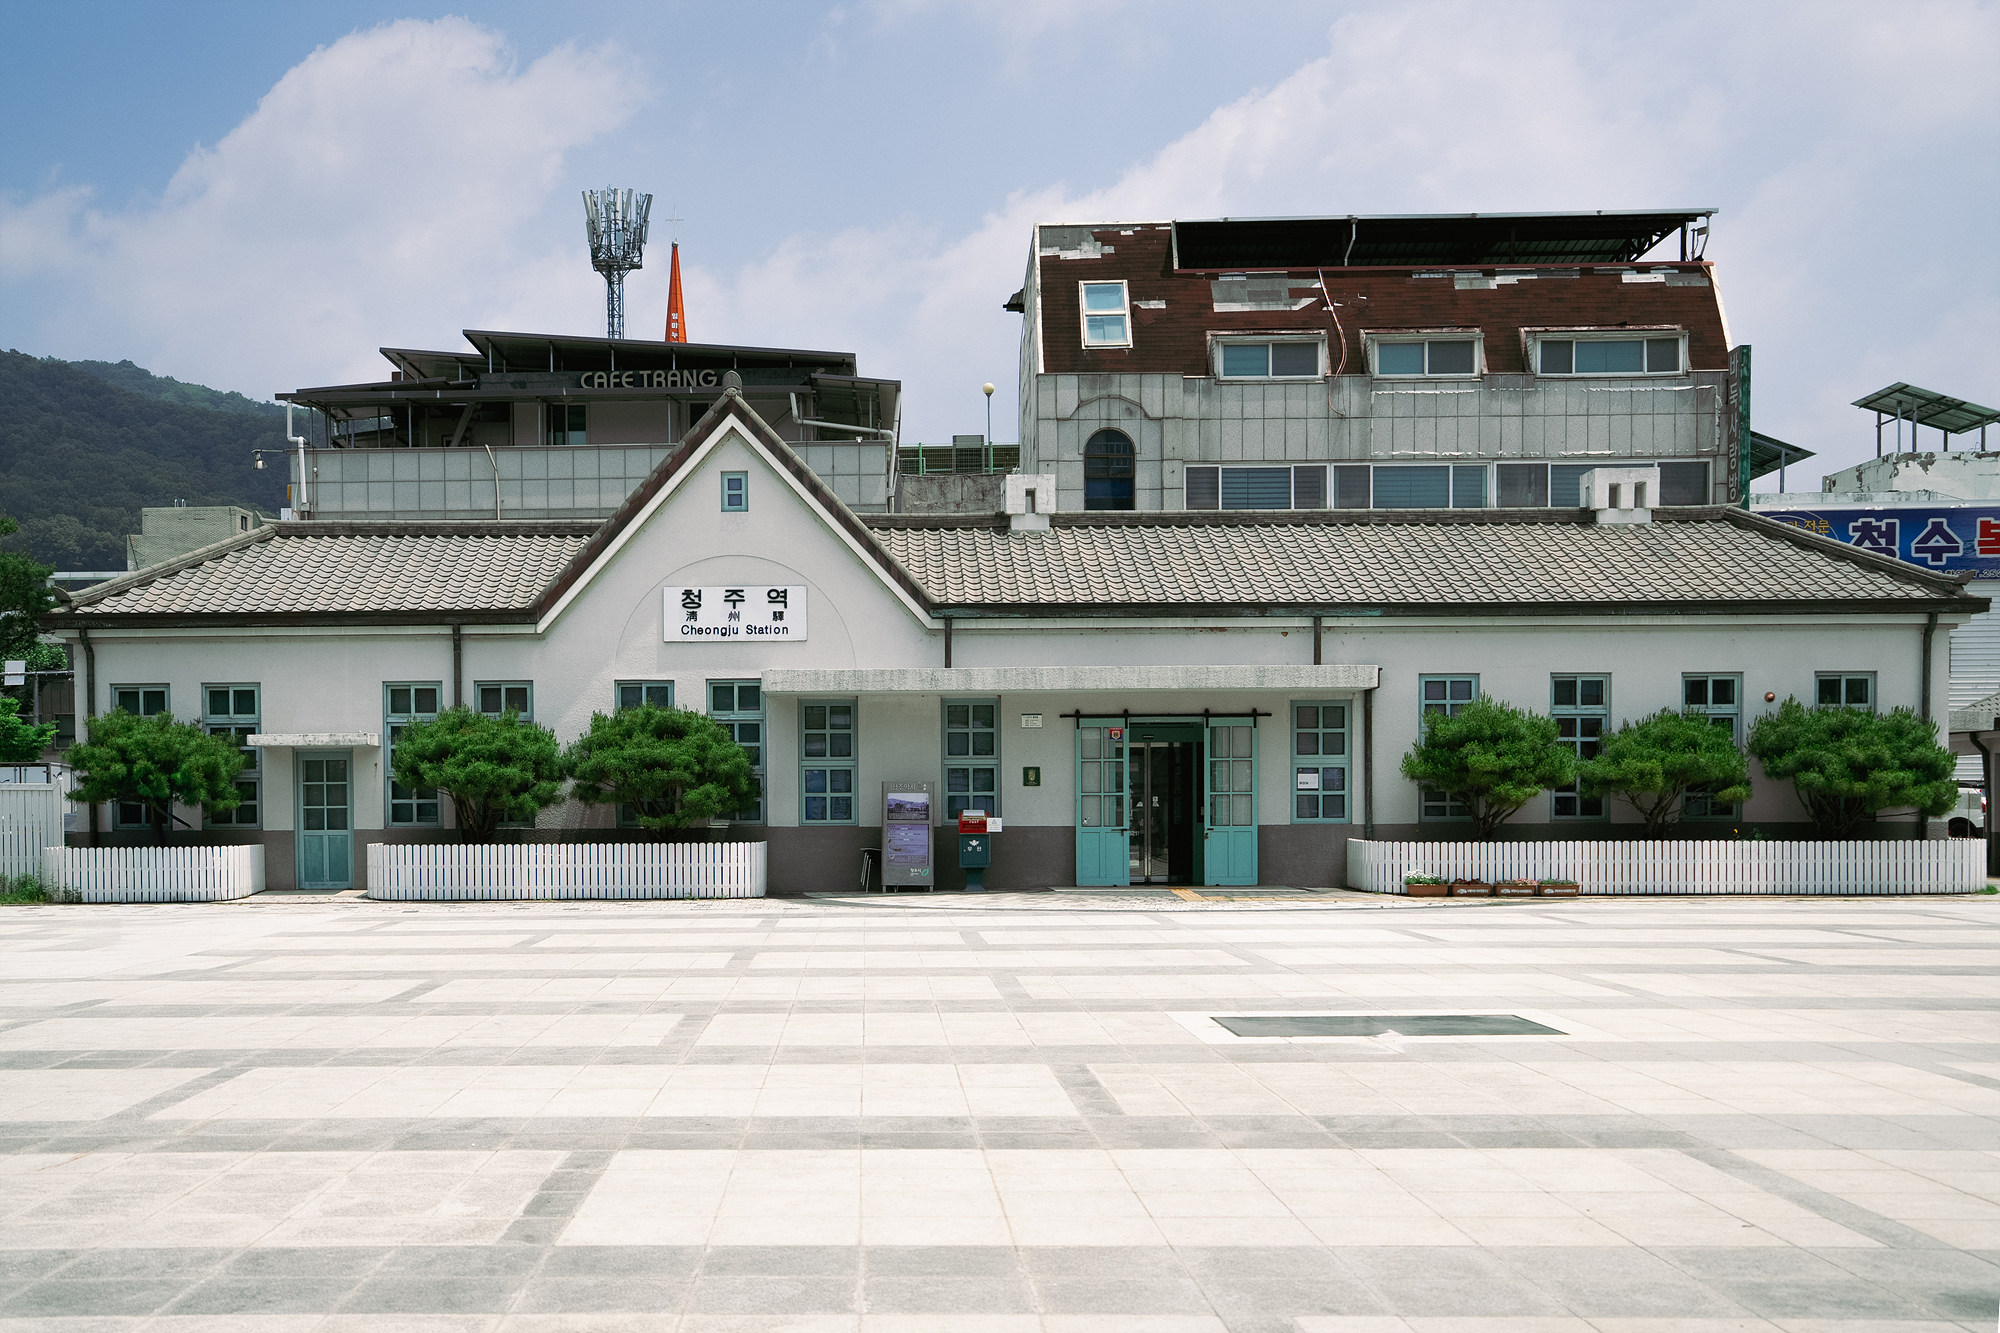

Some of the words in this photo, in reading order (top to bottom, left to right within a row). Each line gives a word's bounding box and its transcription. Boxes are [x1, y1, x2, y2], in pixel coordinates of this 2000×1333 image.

[671, 312, 679, 343] 임마누
[580, 370, 634, 388] CAFE
[639, 369, 718, 388] TRANG
[681, 588, 788, 610] 청주역
[681, 624, 739, 637] Cheongju
[746, 624, 789, 635] Station
